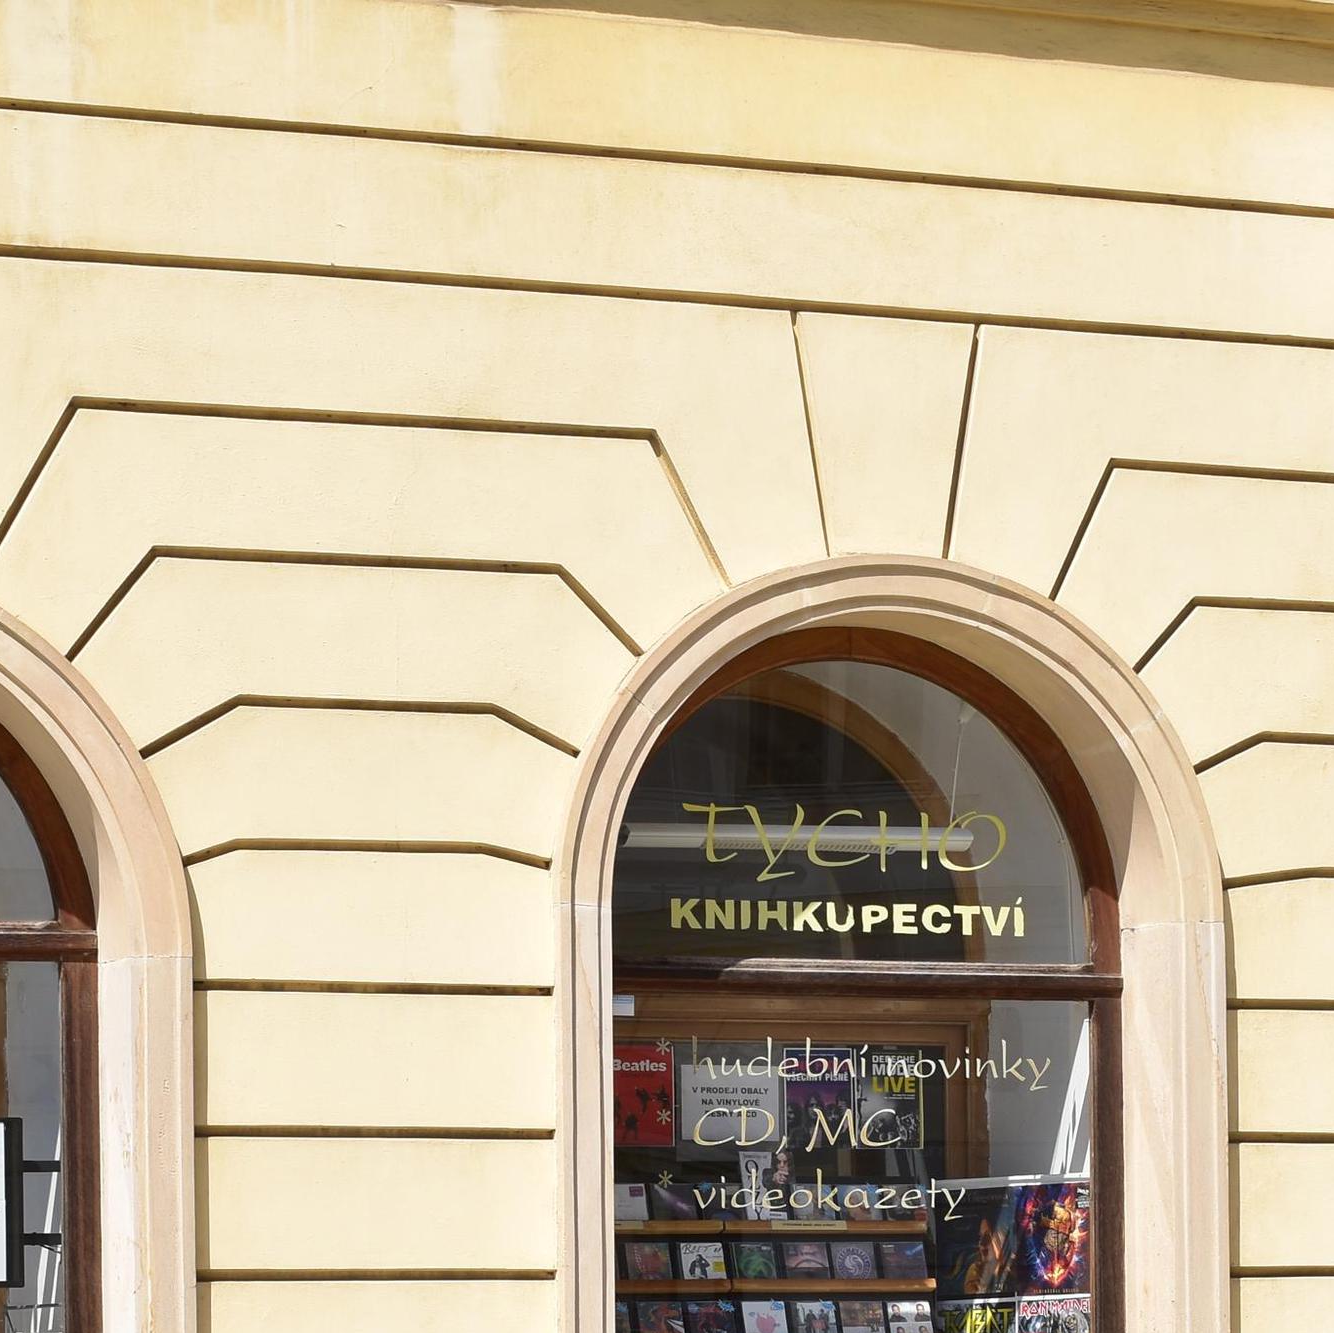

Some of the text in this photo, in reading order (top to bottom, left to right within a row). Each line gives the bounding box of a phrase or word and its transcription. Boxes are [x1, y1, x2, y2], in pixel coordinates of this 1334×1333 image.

[682, 802, 1007, 882] TYCHO
[670, 897, 1024, 937] KNIHKUPECTVÍ
[614, 1059, 667, 1073] Beatles
[692, 1035, 1051, 1091] hudební novinky
[692, 1086, 769, 1095] V PRODEJI OBALY
[701, 1097, 760, 1106] NA VINYLOVÉ
[872, 1077, 916, 1093] LIVE
[805, 1108, 901, 1152] MC
[693, 1168, 966, 1222] videokazety
